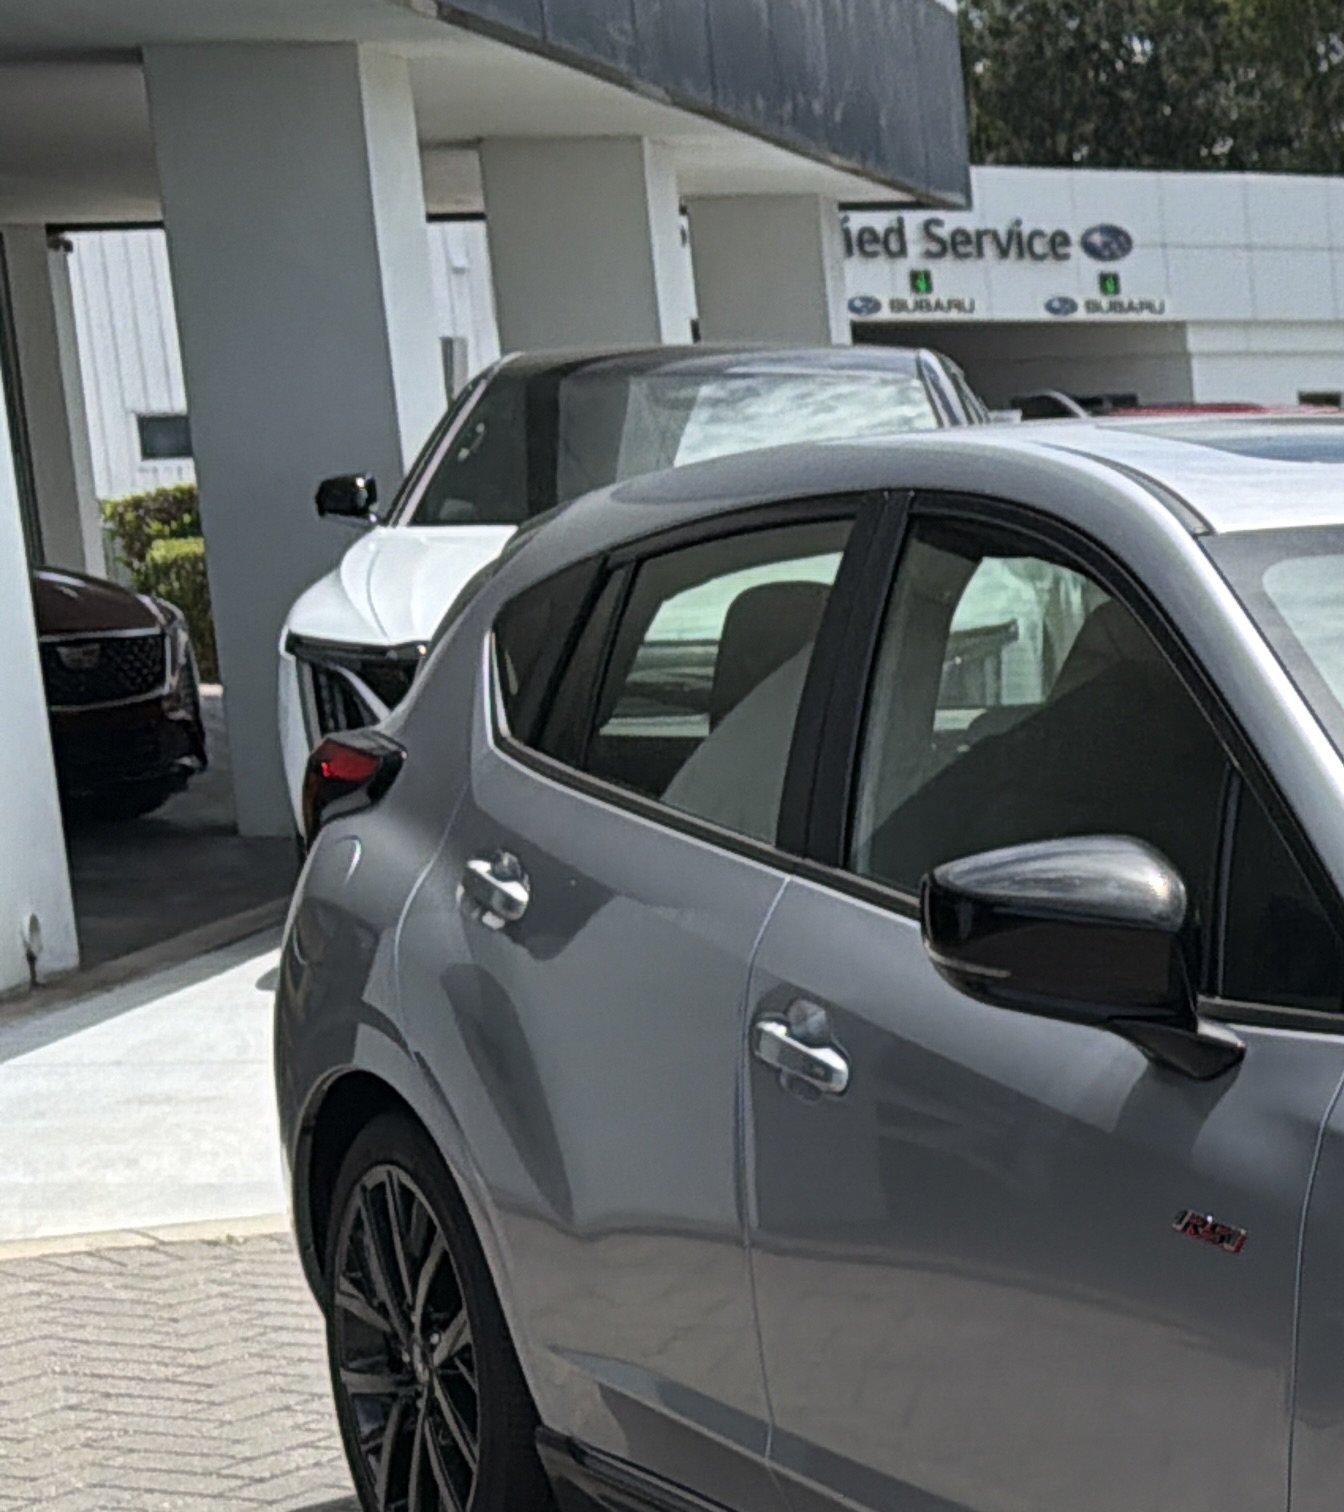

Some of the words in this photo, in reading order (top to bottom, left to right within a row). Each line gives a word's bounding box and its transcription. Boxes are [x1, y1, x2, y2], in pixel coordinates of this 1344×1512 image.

[840, 215, 908, 258] ied
[922, 217, 1072, 261] Service
[888, 298, 976, 314] SUBARU
[1084, 299, 1166, 315] SUBARU
